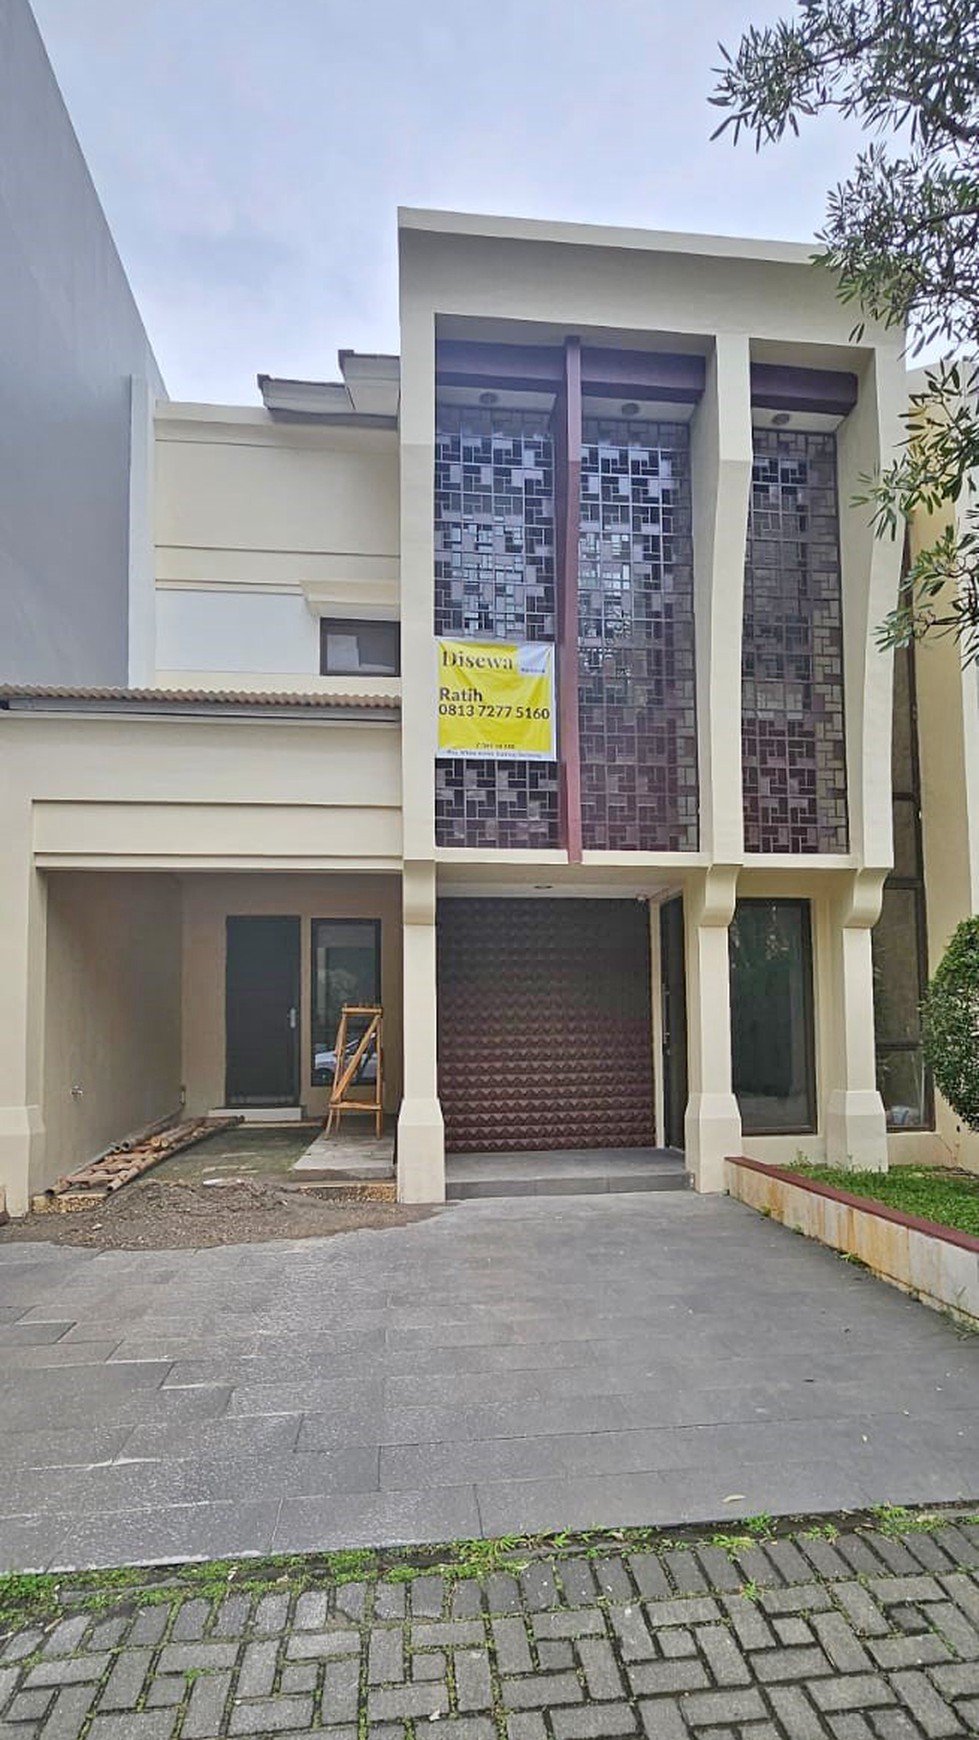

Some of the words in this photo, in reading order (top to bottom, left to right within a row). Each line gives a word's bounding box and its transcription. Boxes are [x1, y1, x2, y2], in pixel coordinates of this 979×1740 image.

[442, 650, 513, 670] Disewa
[440, 687, 483, 702] Ratih
[438, 704, 475, 717] 0813
[478, 705, 512, 718] 7277
[516, 707, 550, 720] 5160
